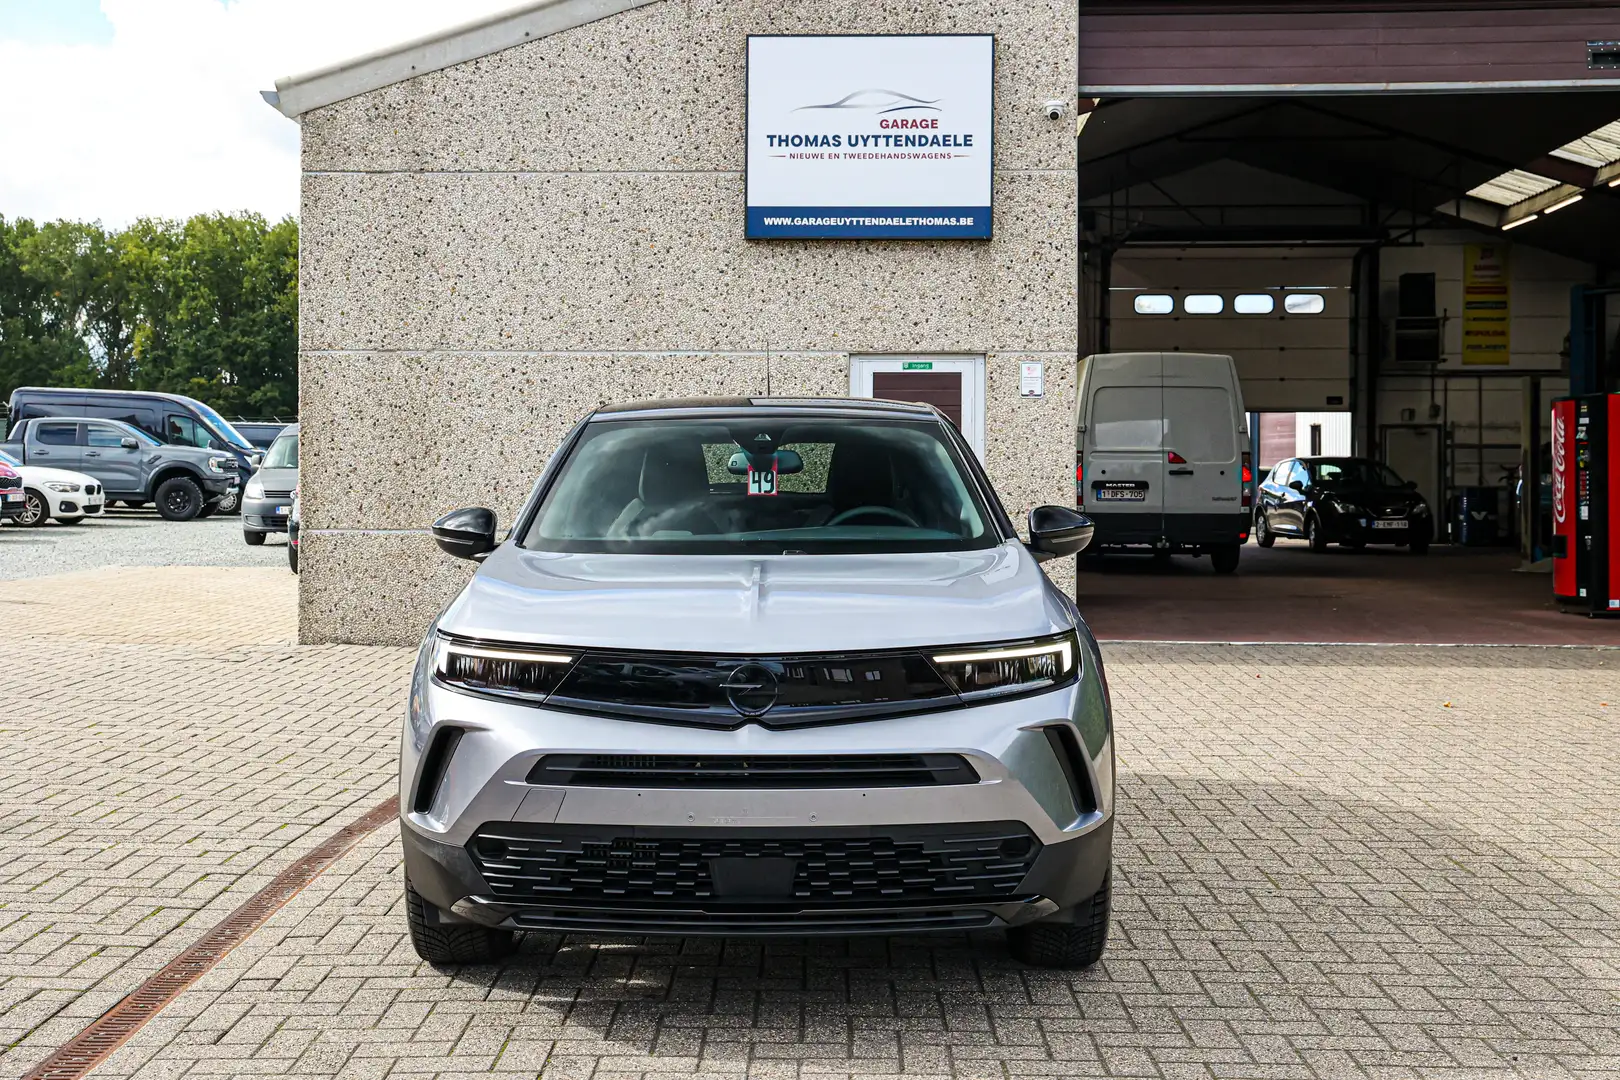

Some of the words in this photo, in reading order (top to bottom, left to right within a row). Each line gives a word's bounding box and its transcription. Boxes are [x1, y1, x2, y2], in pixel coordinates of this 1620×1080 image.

[880, 118, 939, 129] GARAGE
[766, 134, 842, 147] THOMAS
[848, 134, 973, 147] UYTTENDAELE
[789, 152, 825, 160] NIEUWE
[828, 152, 840, 160] EN
[843, 152, 952, 160] TWEEDEHANDSWAGENS
[763, 217, 974, 226] WWW.GARAGEUYTTENDAELETHOMAS.BE
[751, 470, 775, 494] 49
